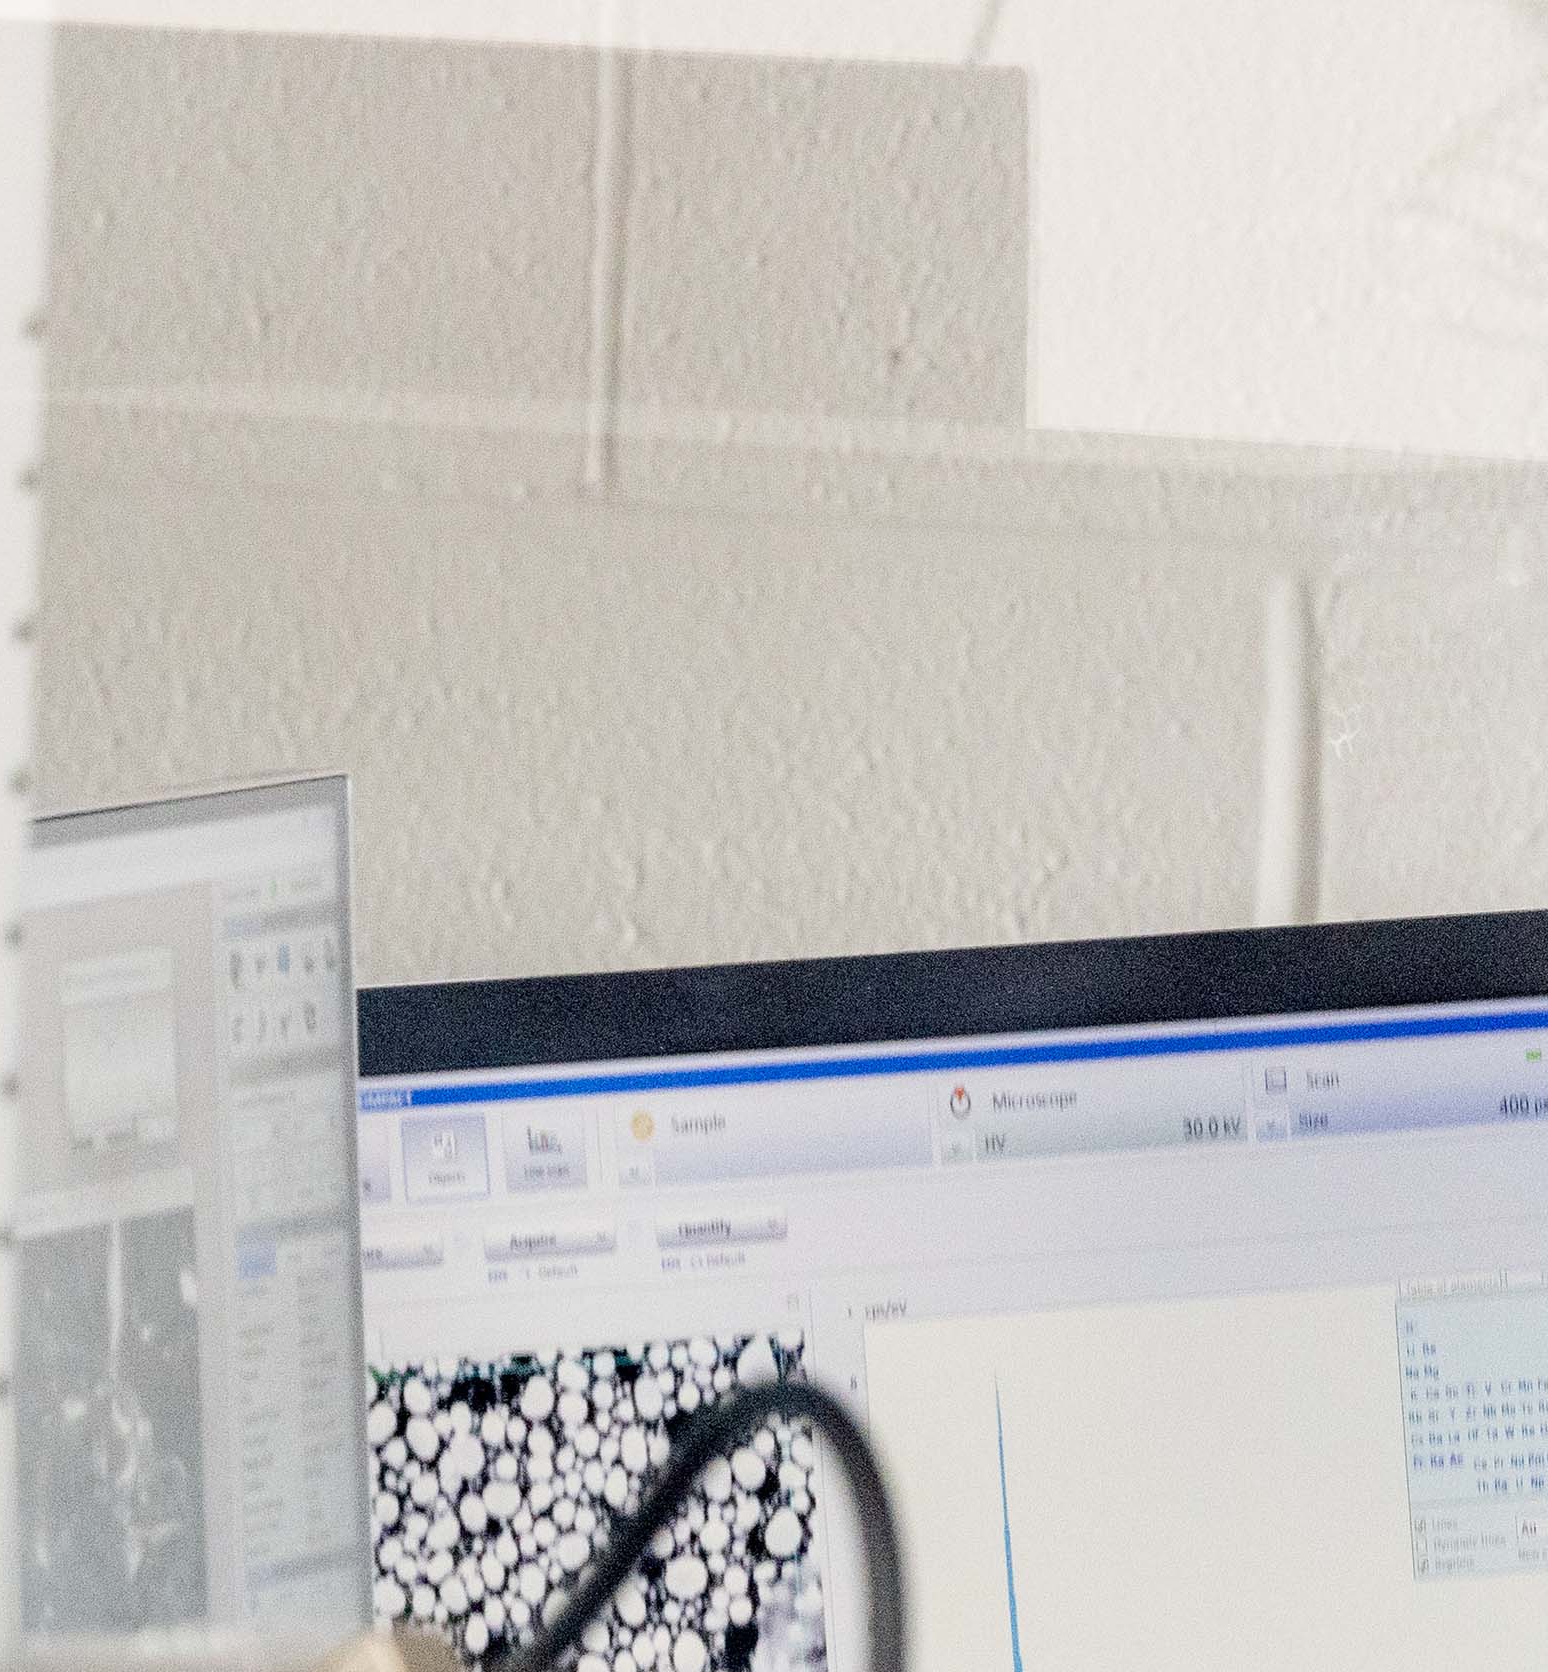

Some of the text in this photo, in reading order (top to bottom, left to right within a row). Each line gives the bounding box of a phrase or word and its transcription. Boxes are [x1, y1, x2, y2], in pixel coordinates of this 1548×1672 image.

[992, 1090, 1077, 1113] Microscope
[1499, 1092, 1530, 1119] 400
[671, 1111, 727, 1136] Sample
